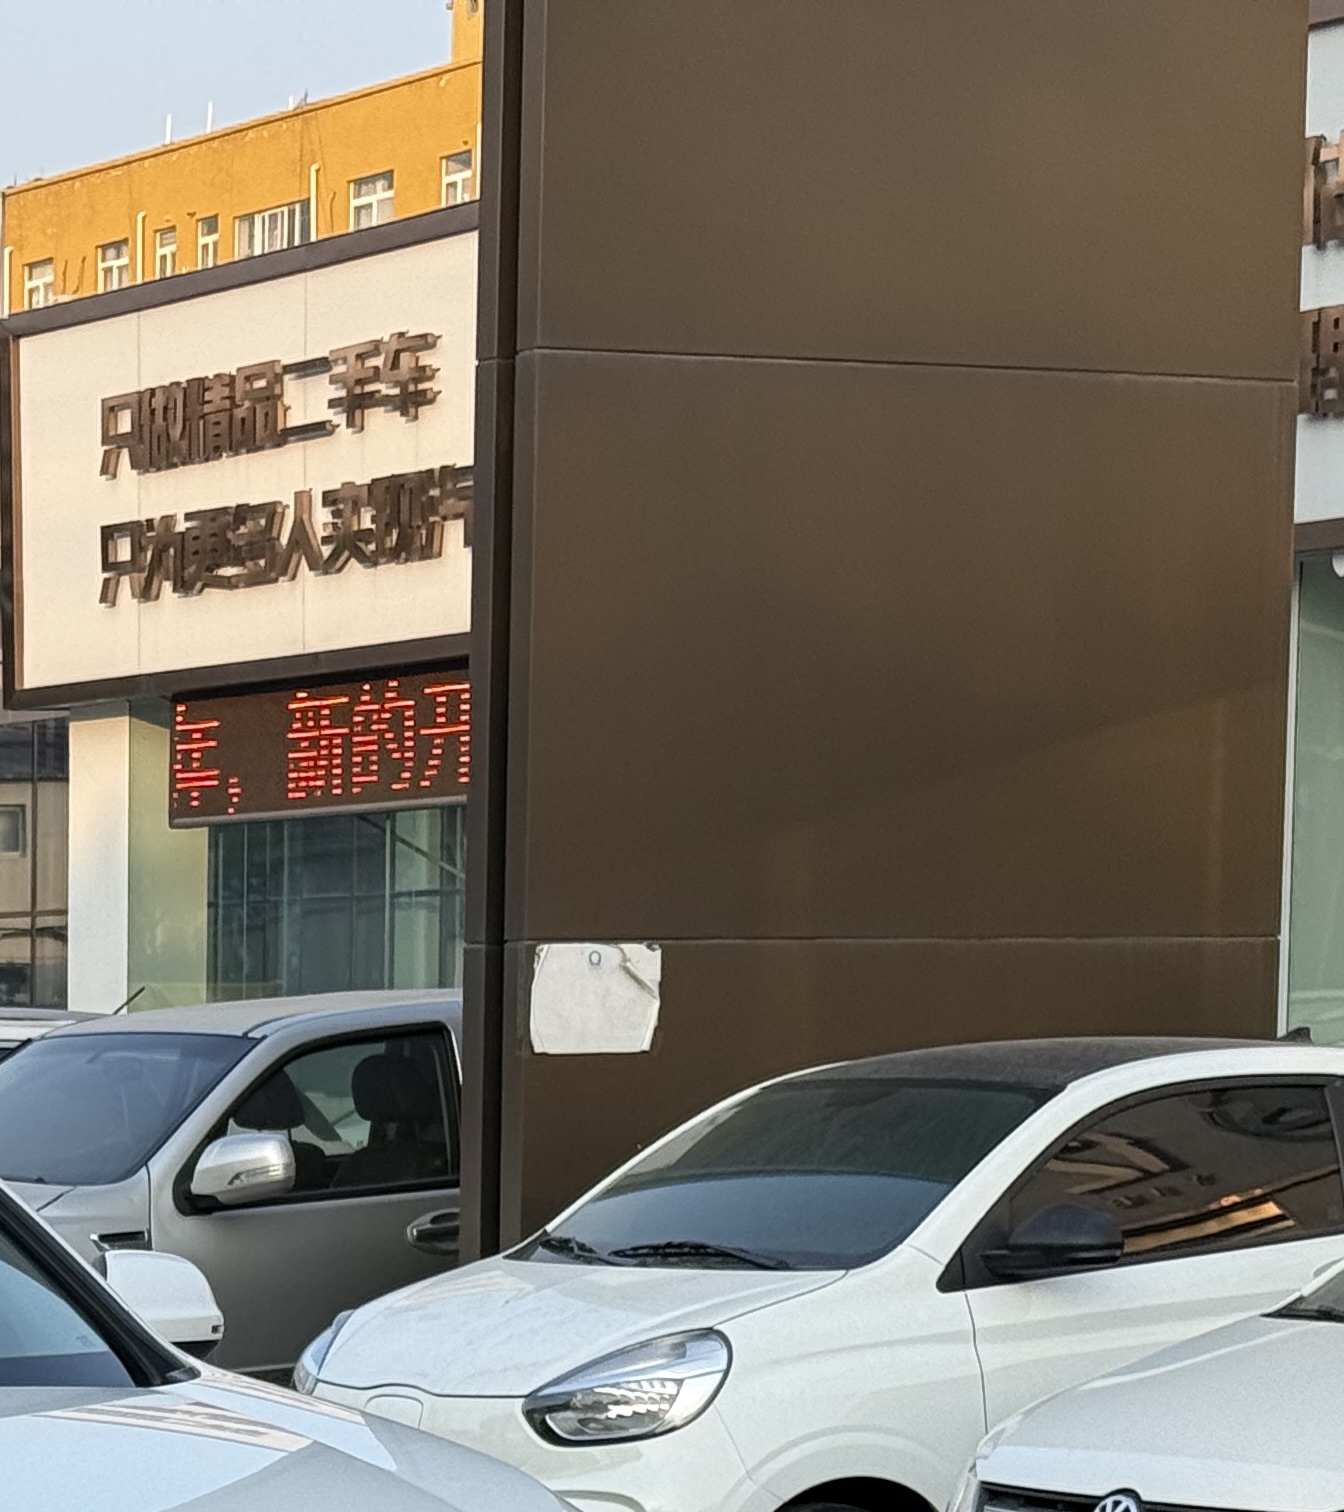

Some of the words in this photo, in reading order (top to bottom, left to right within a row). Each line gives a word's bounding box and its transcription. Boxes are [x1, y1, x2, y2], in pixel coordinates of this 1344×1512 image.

[99, 331, 443, 481] 只做精品二手车
